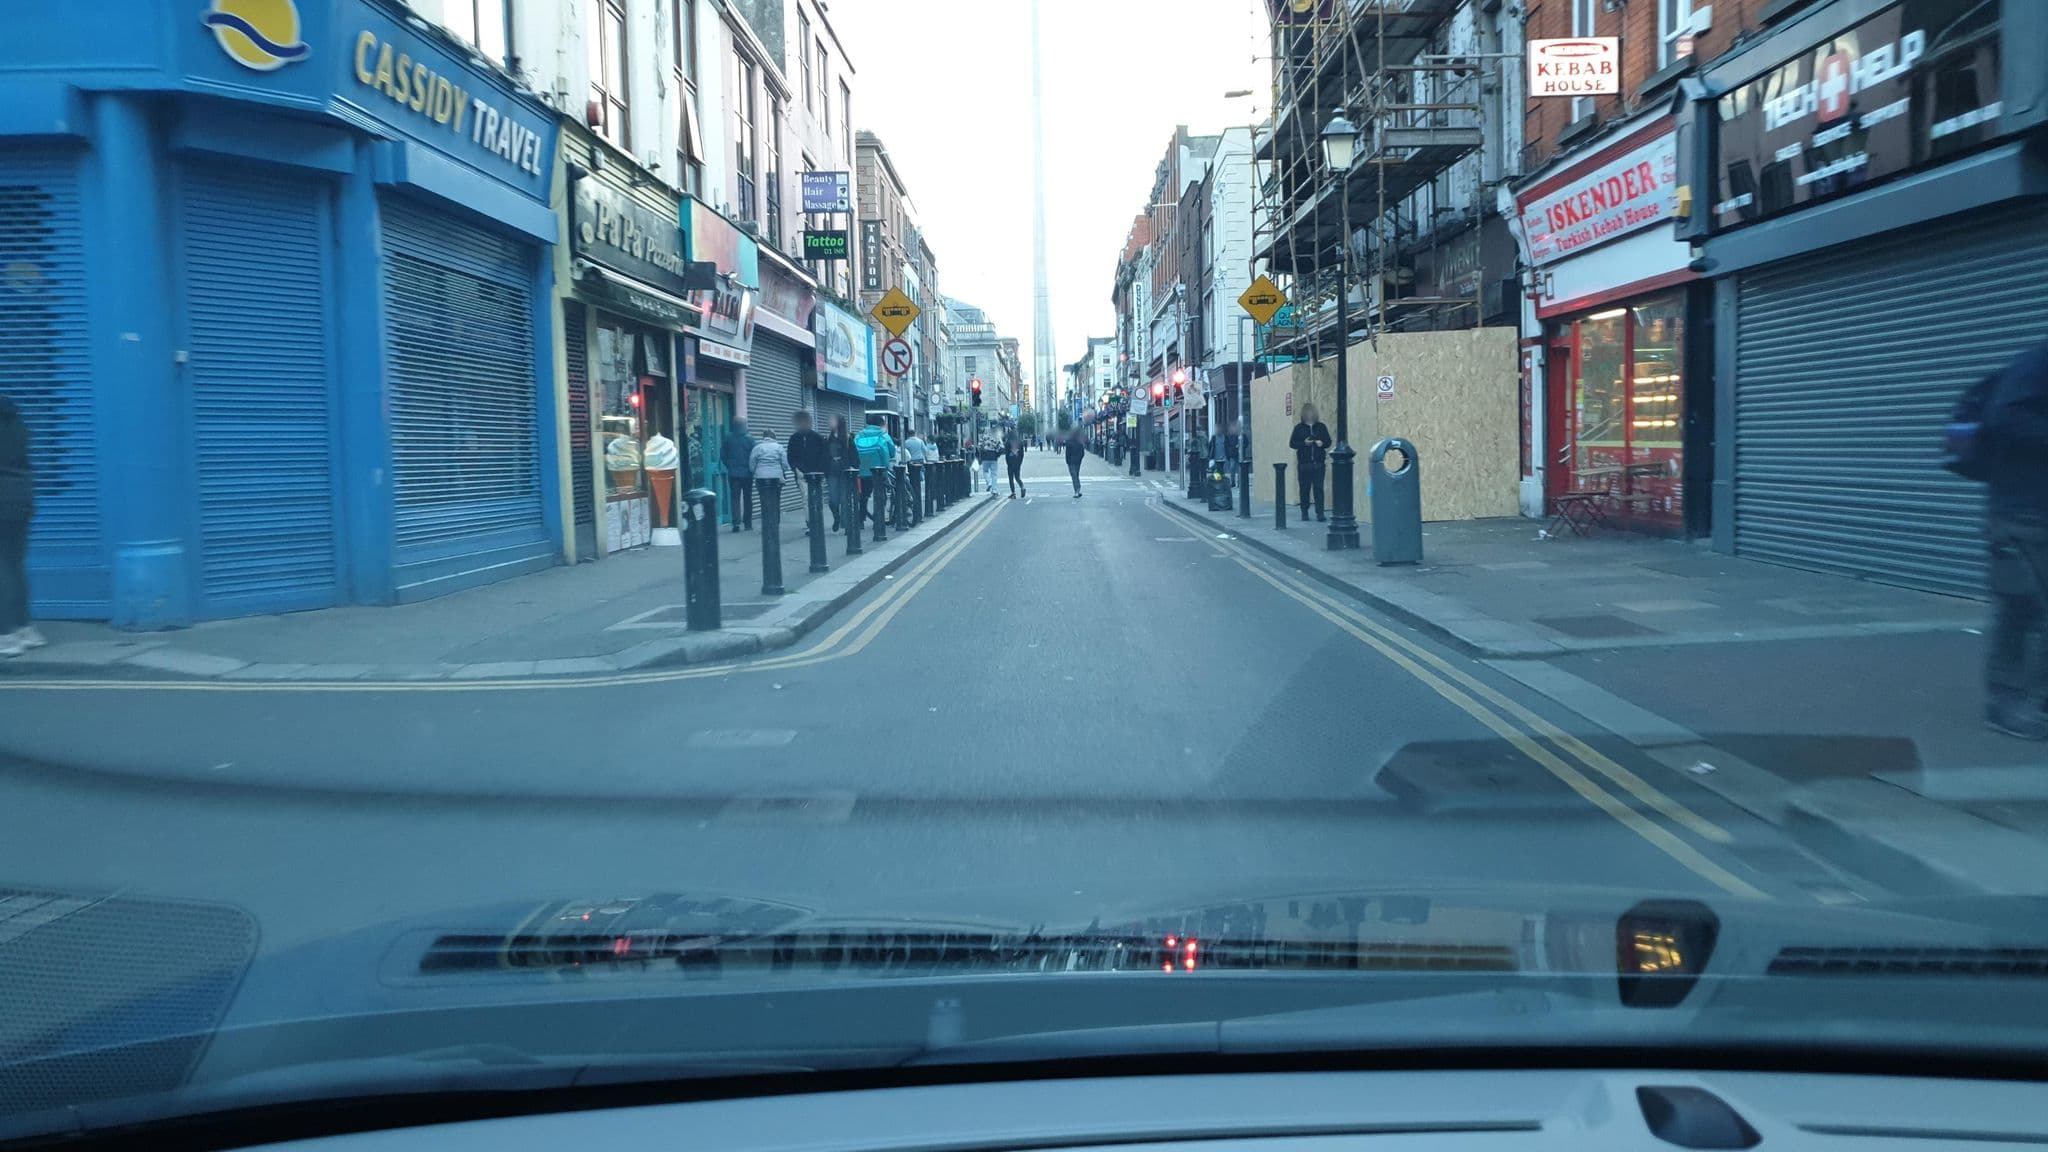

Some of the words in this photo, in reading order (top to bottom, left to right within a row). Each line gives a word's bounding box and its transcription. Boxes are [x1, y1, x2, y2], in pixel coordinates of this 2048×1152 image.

[1537, 61, 1613, 77] KEBAB
[1544, 79, 1605, 92] HOUSE
[1762, 79, 1820, 132] TECH
[1850, 28, 1926, 95] HELP
[355, 30, 469, 133] CASSIDY
[472, 98, 541, 176] TRAVEL
[803, 174, 833, 185] Beauty
[804, 187, 825, 196] Hair
[1545, 160, 1658, 234] ISKENDER
[804, 200, 837, 210] Massage
[1556, 226, 1592, 252] Turkish
[1592, 214, 1625, 239] Kebab
[1625, 202, 1660, 225] House
[806, 235, 844, 248] Tattoo
[867, 224, 876, 286] TATTOO
